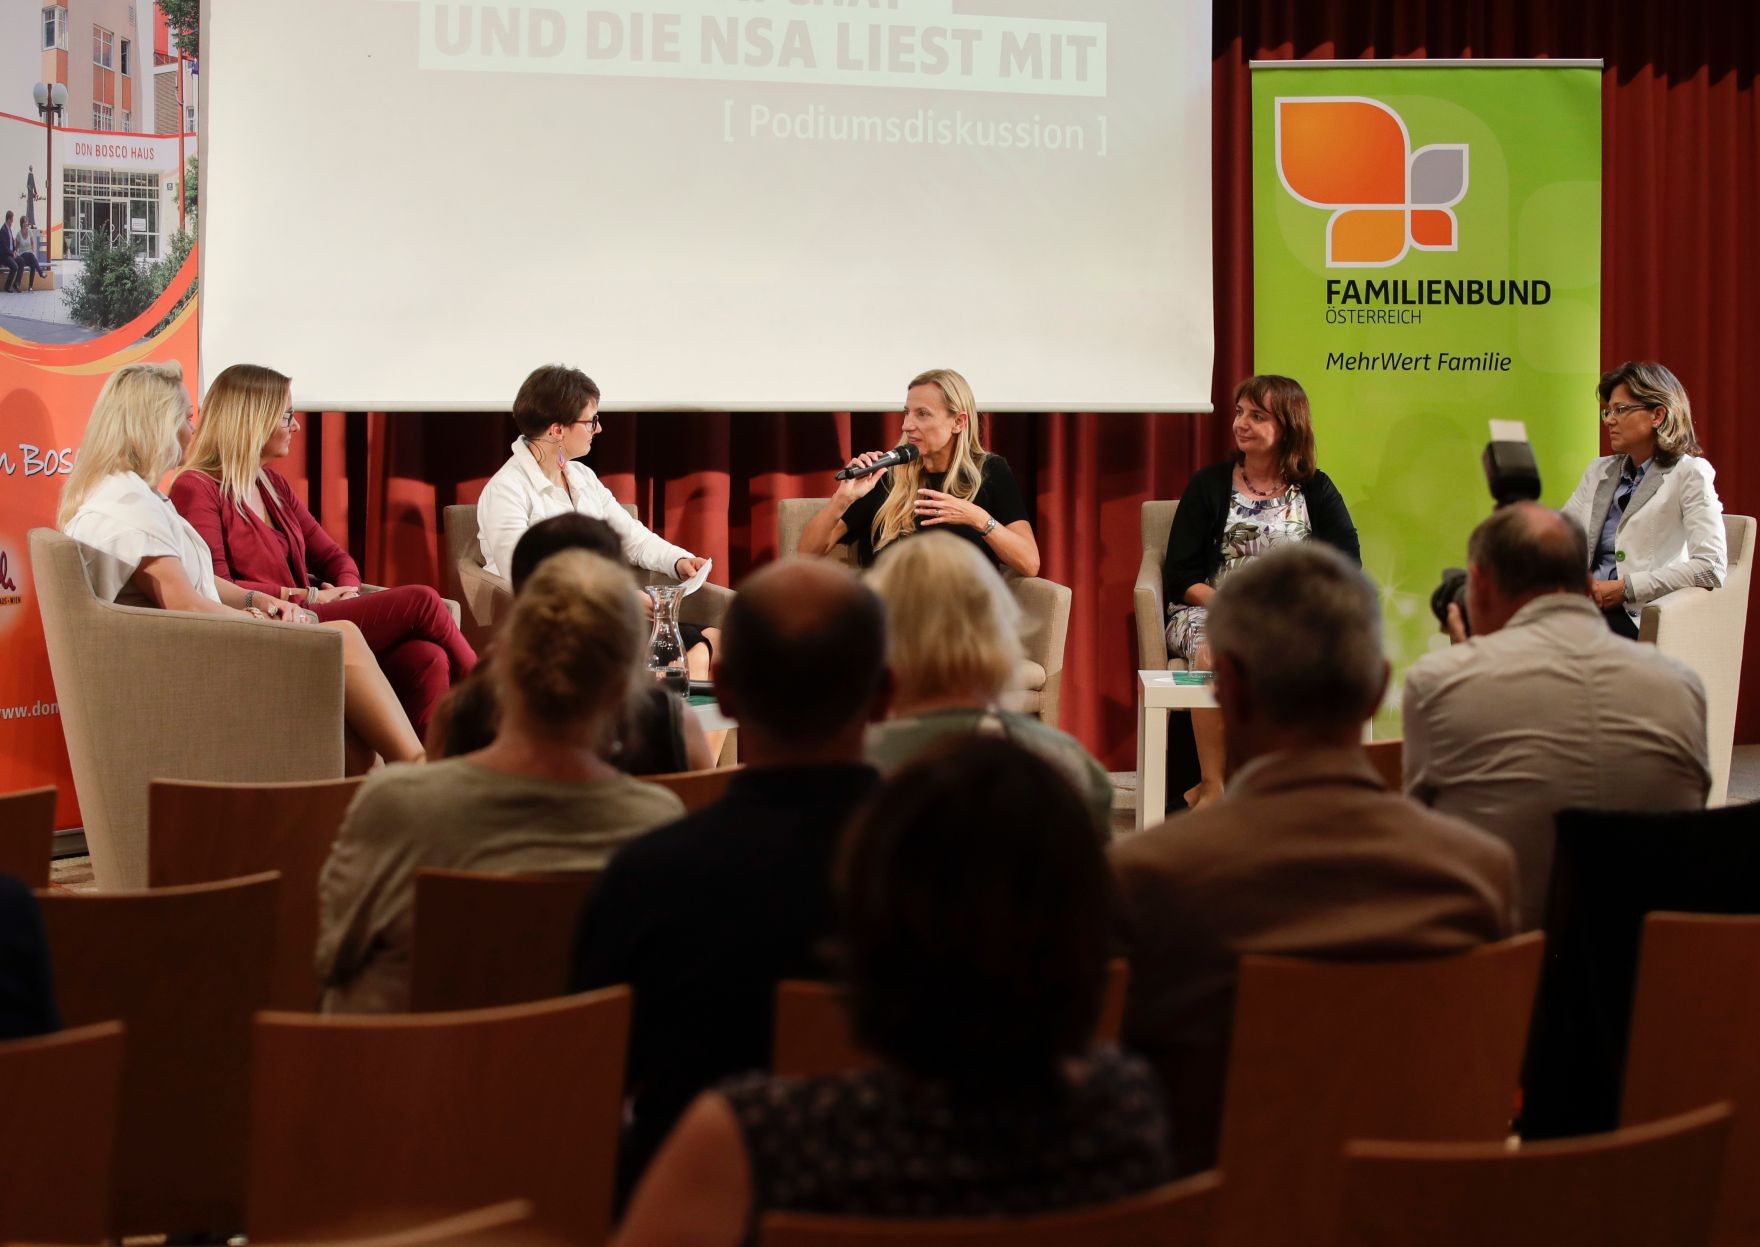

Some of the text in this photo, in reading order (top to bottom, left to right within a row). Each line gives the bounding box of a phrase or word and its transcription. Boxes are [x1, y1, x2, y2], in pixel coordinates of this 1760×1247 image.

[434, 4, 1098, 82] UND DIE NSA LIEST MIT
[750, 103, 1085, 151] Podiumsdiskussion
[75, 142, 155, 160] DON BOSCO HAUS
[1325, 279, 1552, 306] FAMILIENBUND
[1325, 305, 1422, 324] ÖSTERREICH
[1325, 352, 1512, 372] MehrWert Familie
[0, 699, 60, 720] ww.don
